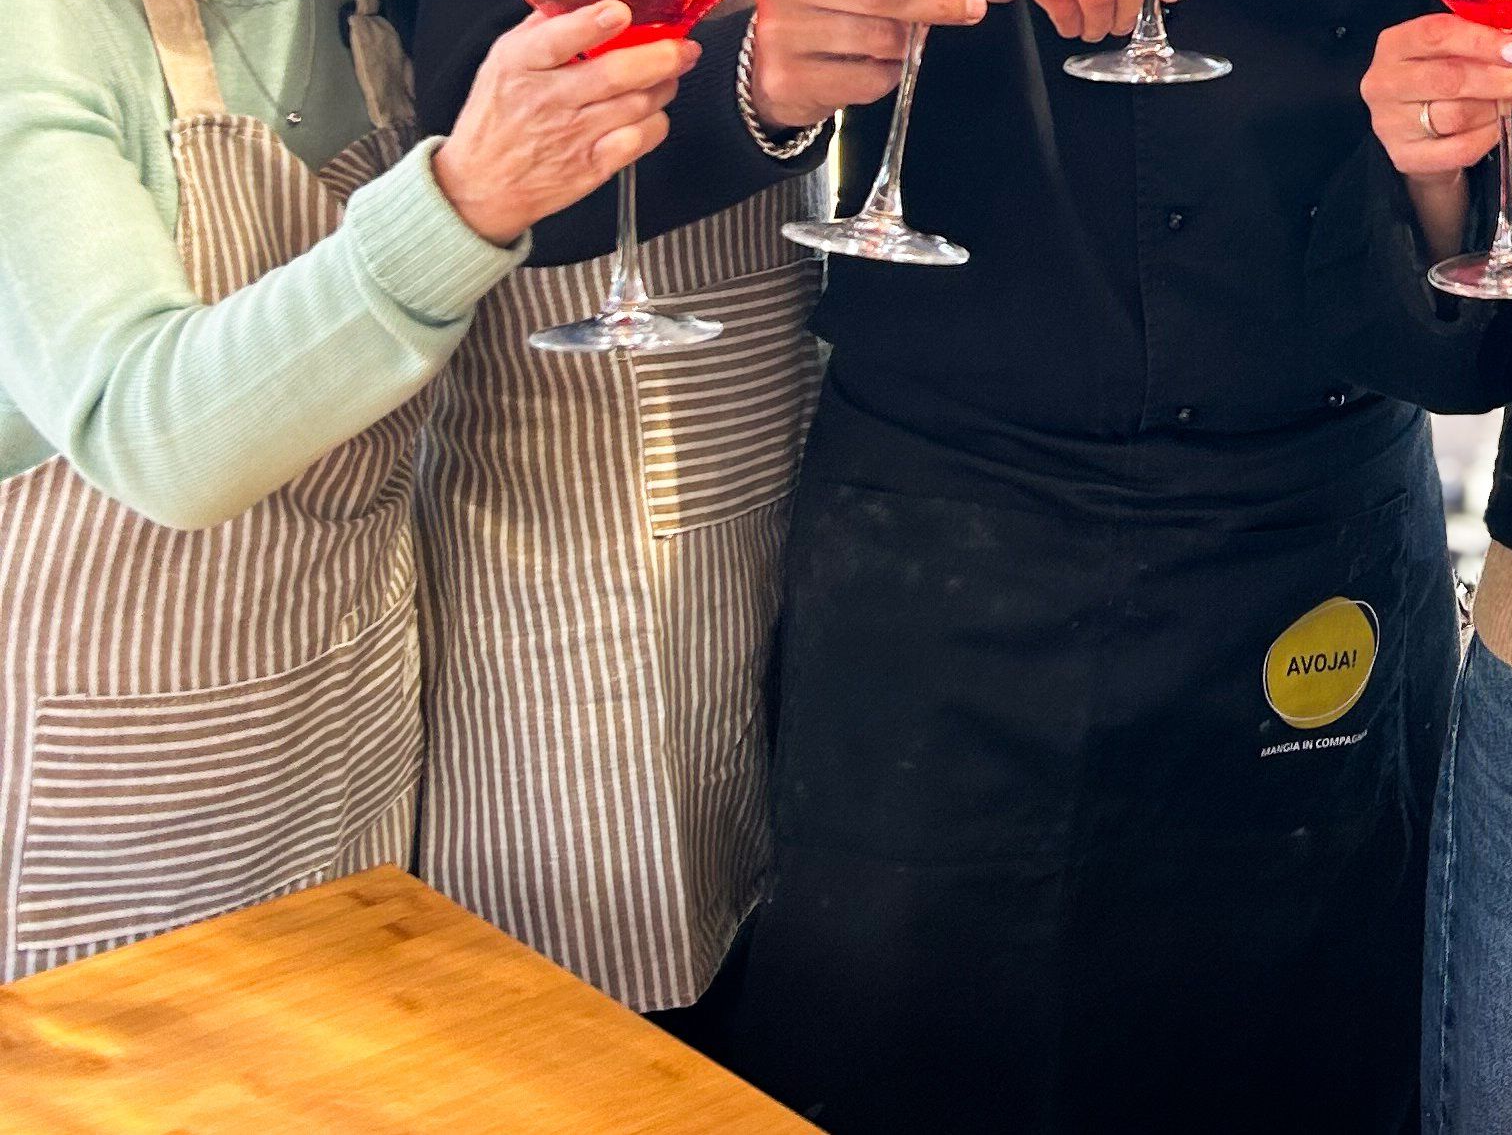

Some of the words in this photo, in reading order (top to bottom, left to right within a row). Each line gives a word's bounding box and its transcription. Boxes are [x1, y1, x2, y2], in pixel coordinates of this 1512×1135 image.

[1286, 649, 1357, 676] AVOJA!
[1260, 741, 1300, 758] MANGIA
[1302, 739, 1314, 750] IN
[1315, 729, 1368, 749] COMPAG
